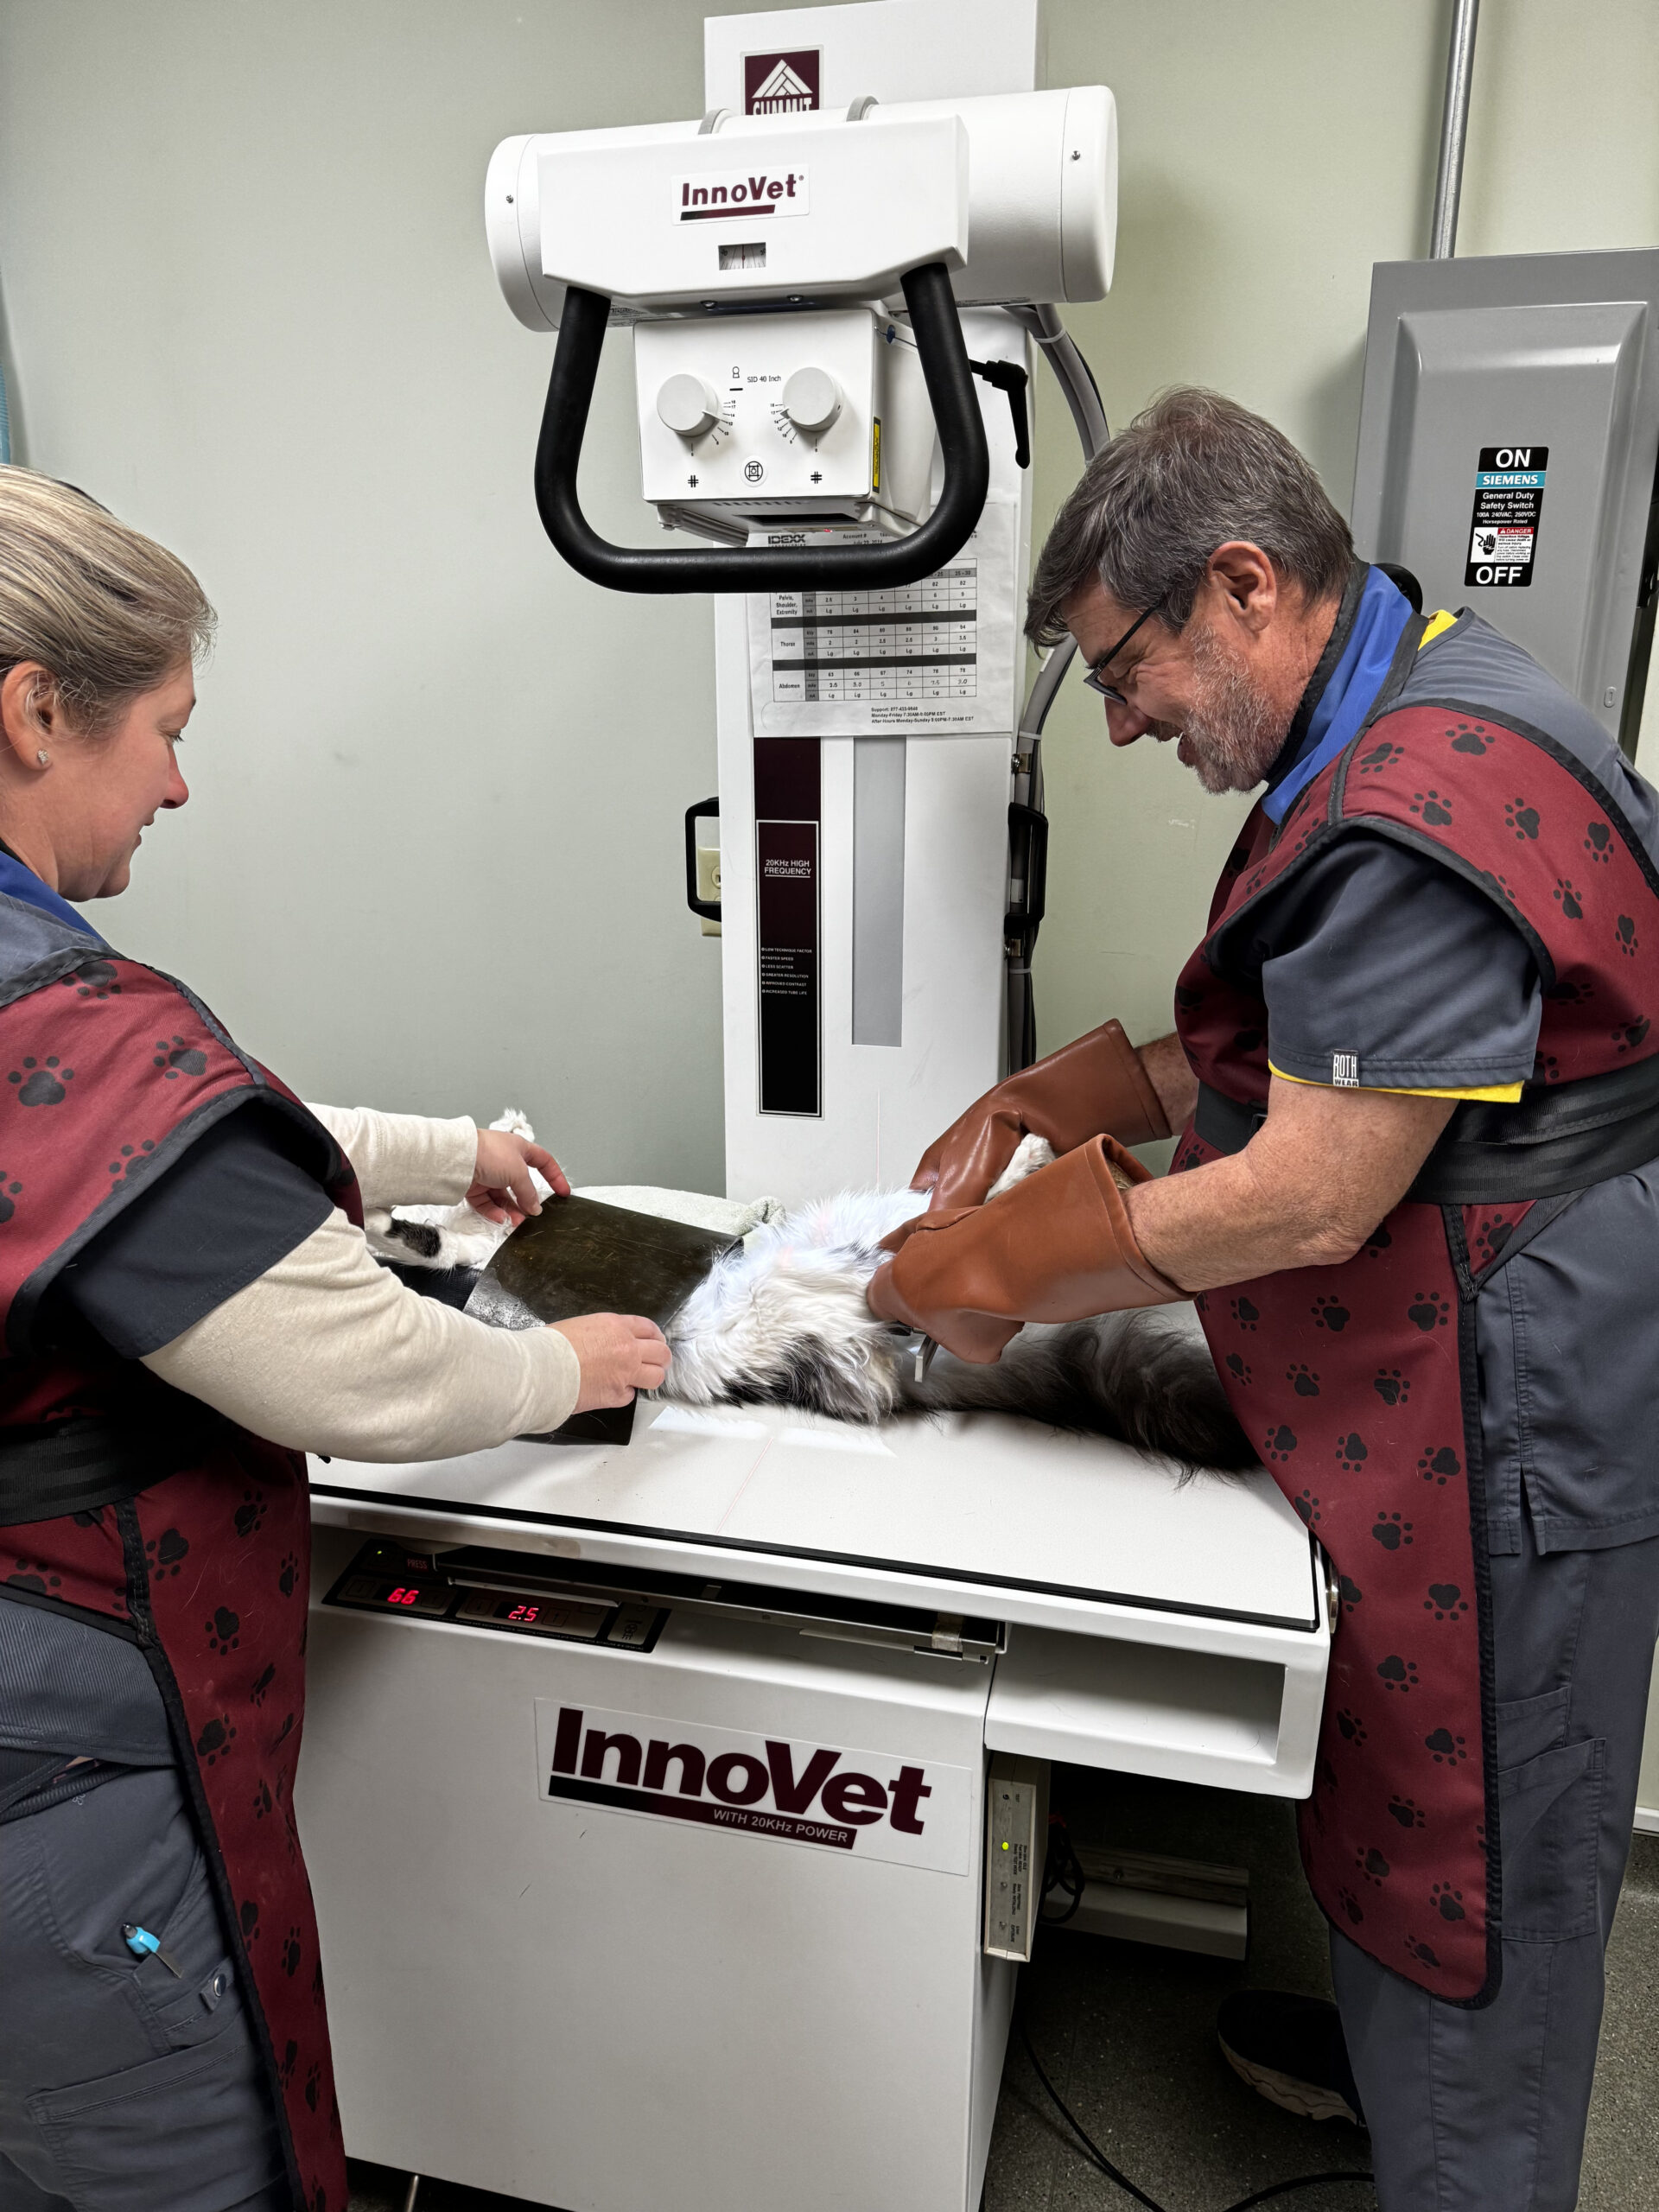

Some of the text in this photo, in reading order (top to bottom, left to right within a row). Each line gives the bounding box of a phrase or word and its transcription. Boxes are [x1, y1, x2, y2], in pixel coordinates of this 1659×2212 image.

[1495, 448, 1531, 468] ON
[1482, 474, 1538, 486] SIEMENS
[1516, 492, 1535, 501] Duty
[1480, 501, 1535, 511] Safety Switch
[767, 534, 806, 544] IDEXX
[1476, 565, 1523, 585] OFF
[764, 867, 812, 875] FREQUENCY
[766, 859, 789, 868] 20KHz
[1333, 1054, 1357, 1078] ROTH
[407, 1558, 428, 1570] PRESS
[387, 1587, 420, 1605] 66
[508, 1605, 539, 1623] 2.5
[551, 1707, 933, 1836] InnoVet
[714, 1808, 849, 1843] WITH 20KHz POWER
